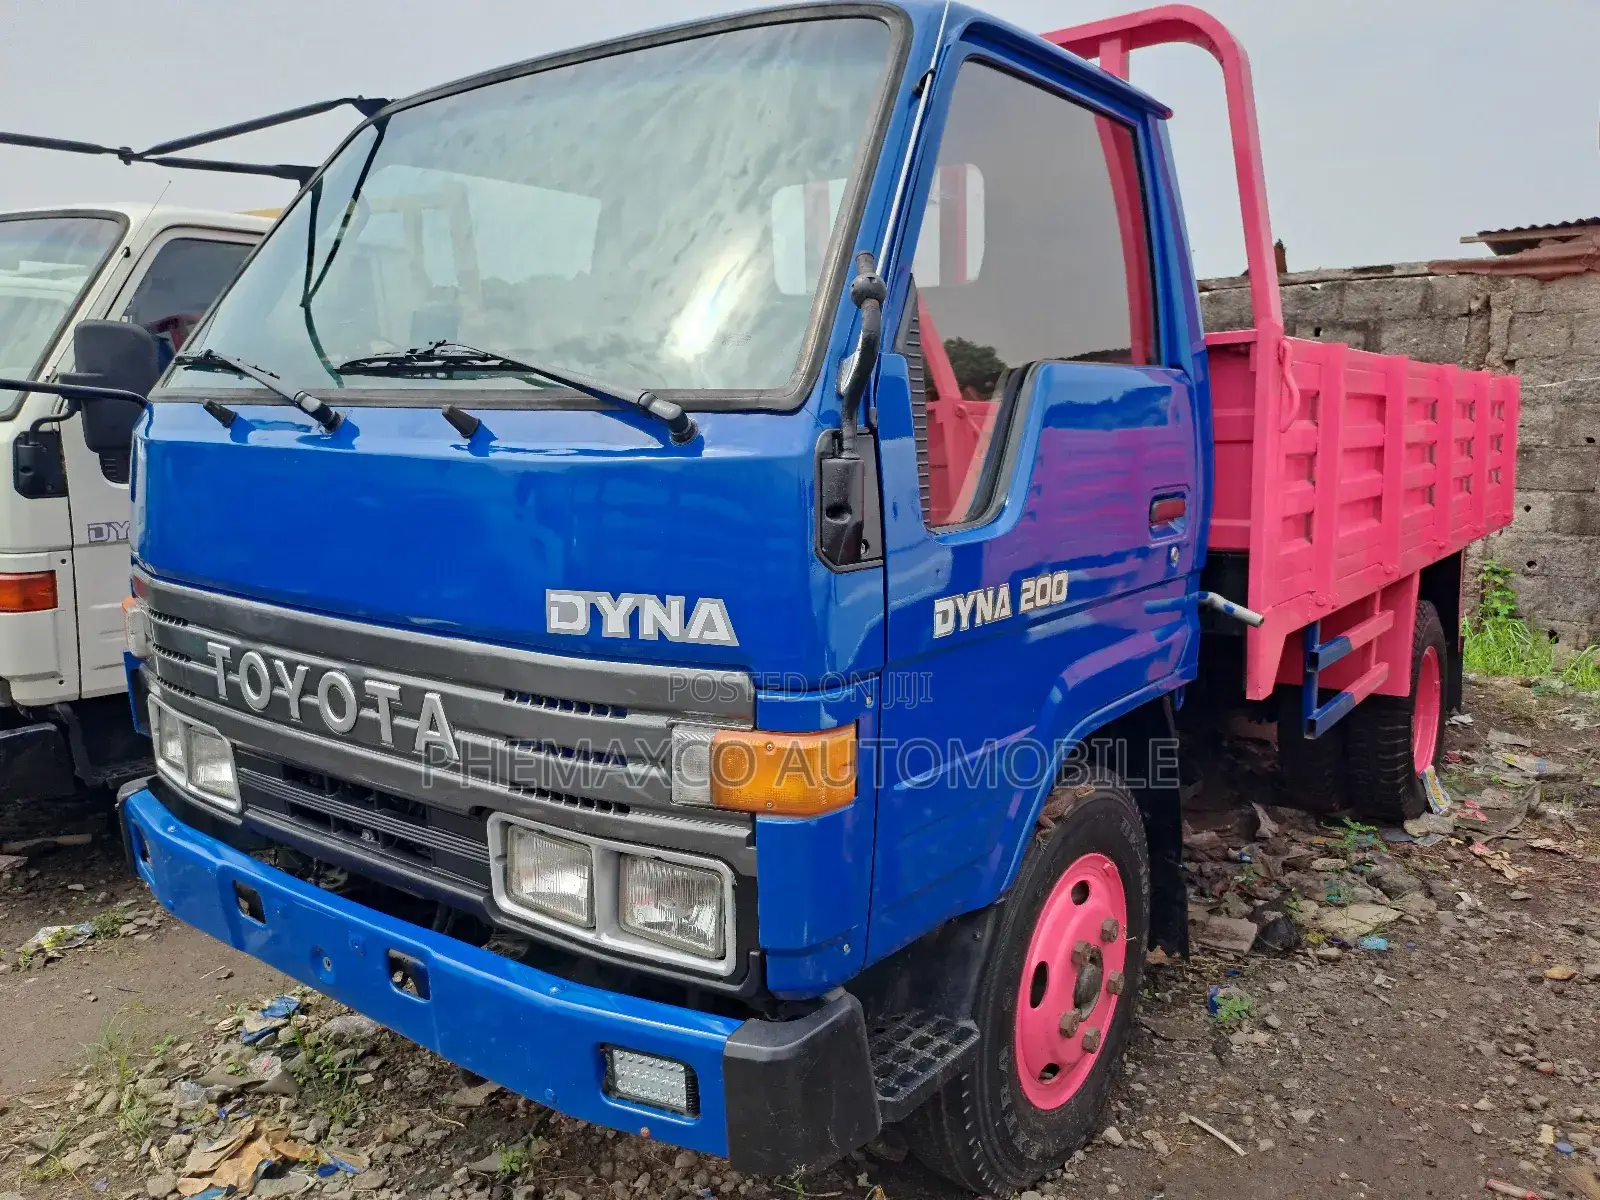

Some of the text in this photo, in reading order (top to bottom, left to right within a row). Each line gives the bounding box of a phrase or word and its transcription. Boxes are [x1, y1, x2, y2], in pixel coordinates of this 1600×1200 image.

[546, 589, 739, 646] DYNA
[933, 570, 1069, 639] DYNA 200
[207, 641, 462, 763] TOYOTA
